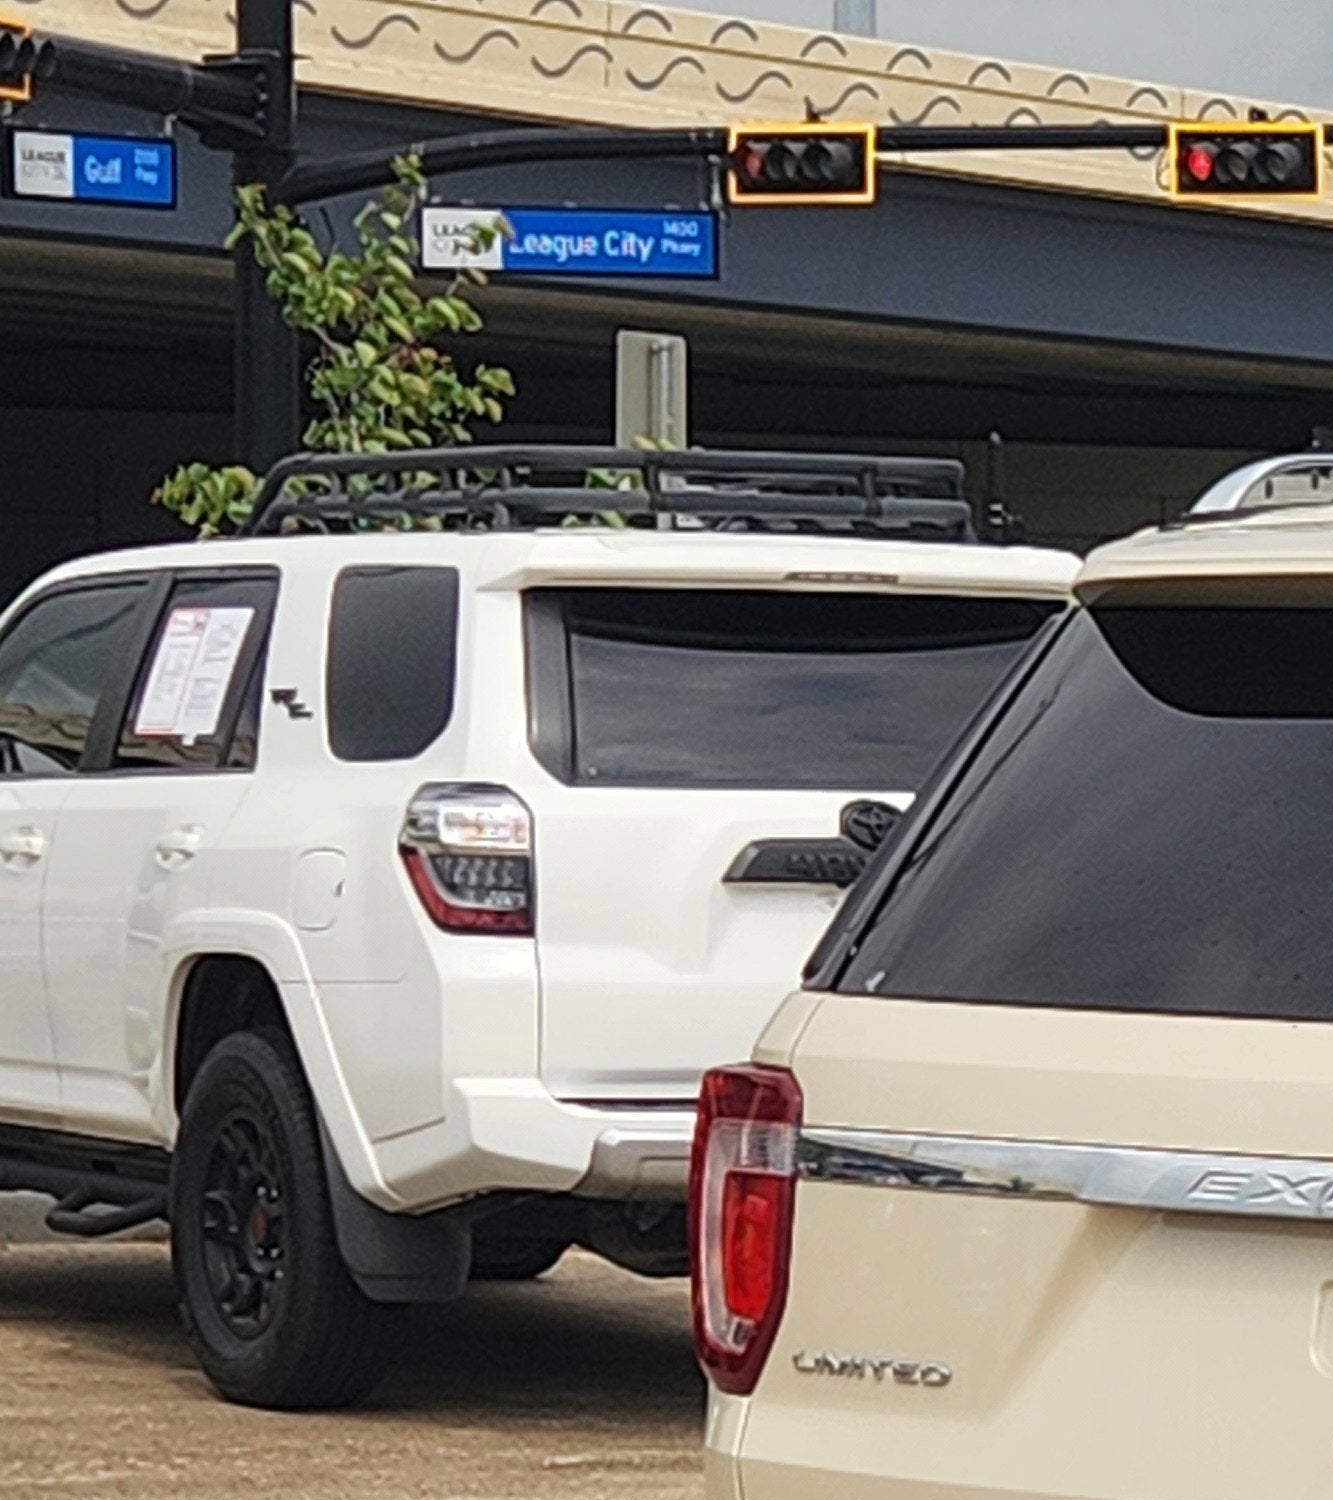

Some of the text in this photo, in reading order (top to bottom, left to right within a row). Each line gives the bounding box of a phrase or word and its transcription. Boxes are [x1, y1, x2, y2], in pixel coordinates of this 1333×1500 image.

[84, 155, 122, 184] Gulf
[509, 230, 654, 263] League City
[792, 1350, 953, 1388] LIMITED
